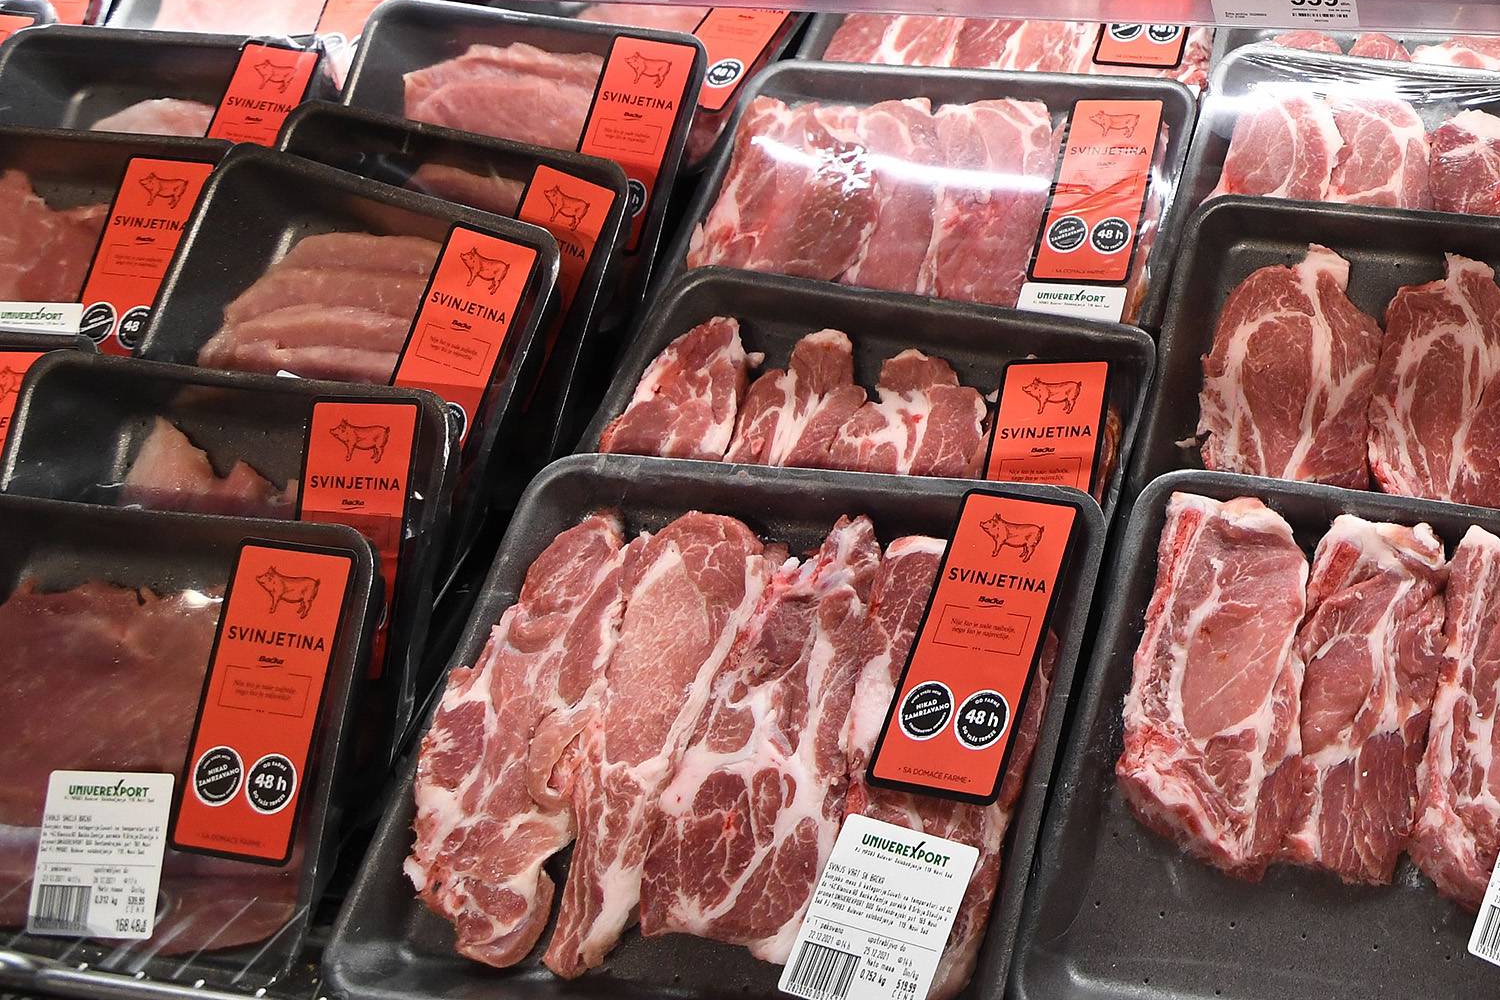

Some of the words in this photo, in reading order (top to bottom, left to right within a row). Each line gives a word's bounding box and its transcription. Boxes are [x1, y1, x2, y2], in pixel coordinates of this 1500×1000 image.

[602, 90, 675, 111] SVINJETINA
[1097, 229, 1114, 240] 48
[1116, 230, 1124, 240] h
[1037, 292, 1106, 303] UNIVEREXPORT
[430, 290, 506, 325] SVINJETINA
[123, 320, 140, 331] 48
[1000, 424, 1092, 440] SVINJETINA
[309, 474, 401, 492] SVINJETINA
[948, 566, 1047, 593] SVINJETINA
[227, 625, 325, 653] SVINJETINA
[904, 703, 949, 720] ZAMRZAVANO
[916, 699, 937, 710] NIKAD
[965, 709, 986, 725] 48
[988, 712, 998, 727] h
[197, 766, 241, 788] ZAMRZAVANO
[206, 762, 229, 777] NIKAD
[69, 783, 150, 799] UNIVEREXPORT
[254, 773, 275, 791] 48
[276, 775, 287, 793] h
[862, 833, 950, 868] UNIVEREXPORT
